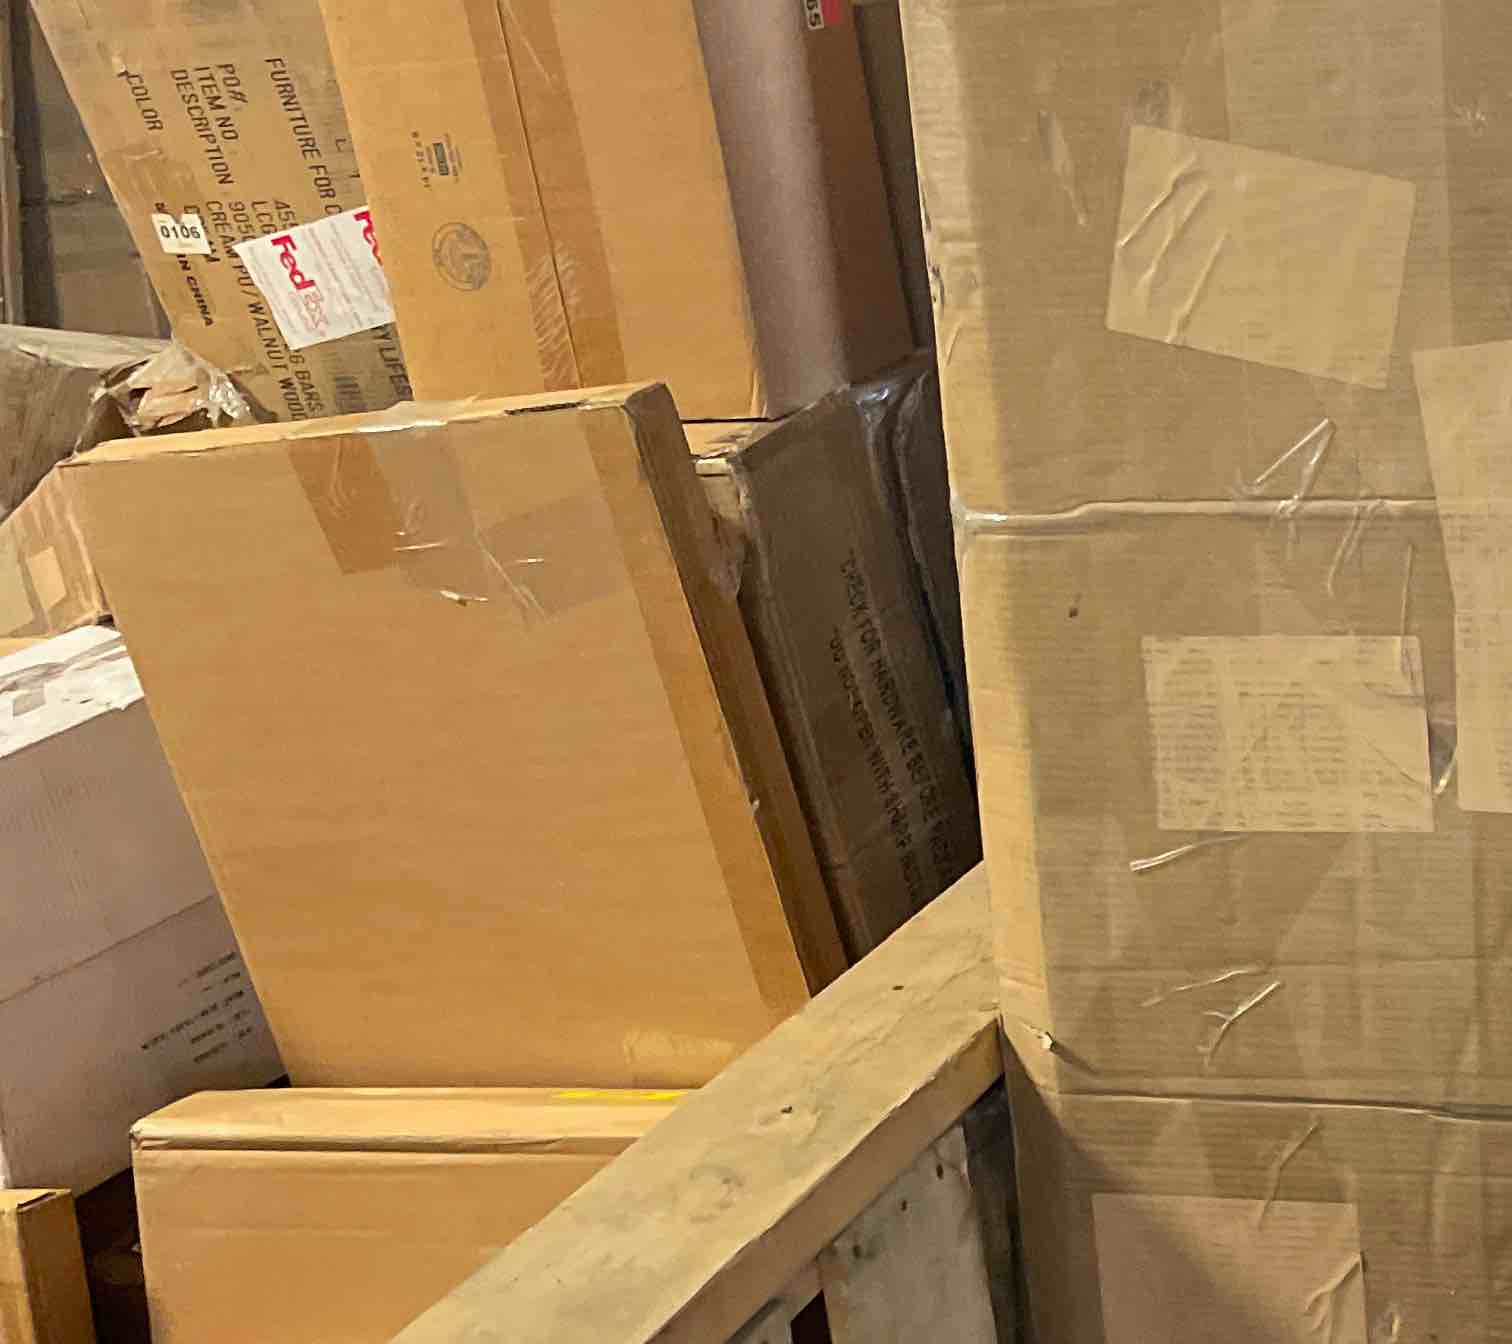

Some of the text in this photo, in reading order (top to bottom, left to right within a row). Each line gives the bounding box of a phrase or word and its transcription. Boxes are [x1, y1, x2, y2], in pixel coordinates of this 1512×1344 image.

[127, 72, 164, 131] COLOR
[193, 65, 227, 112] ITEM
[170, 68, 235, 185] DESCRIPTION
[264, 56, 322, 161] FURNITURE
[308, 164, 337, 200] FOR
[205, 200, 241, 259] CREAM
[186, 274, 214, 328] CHINA
